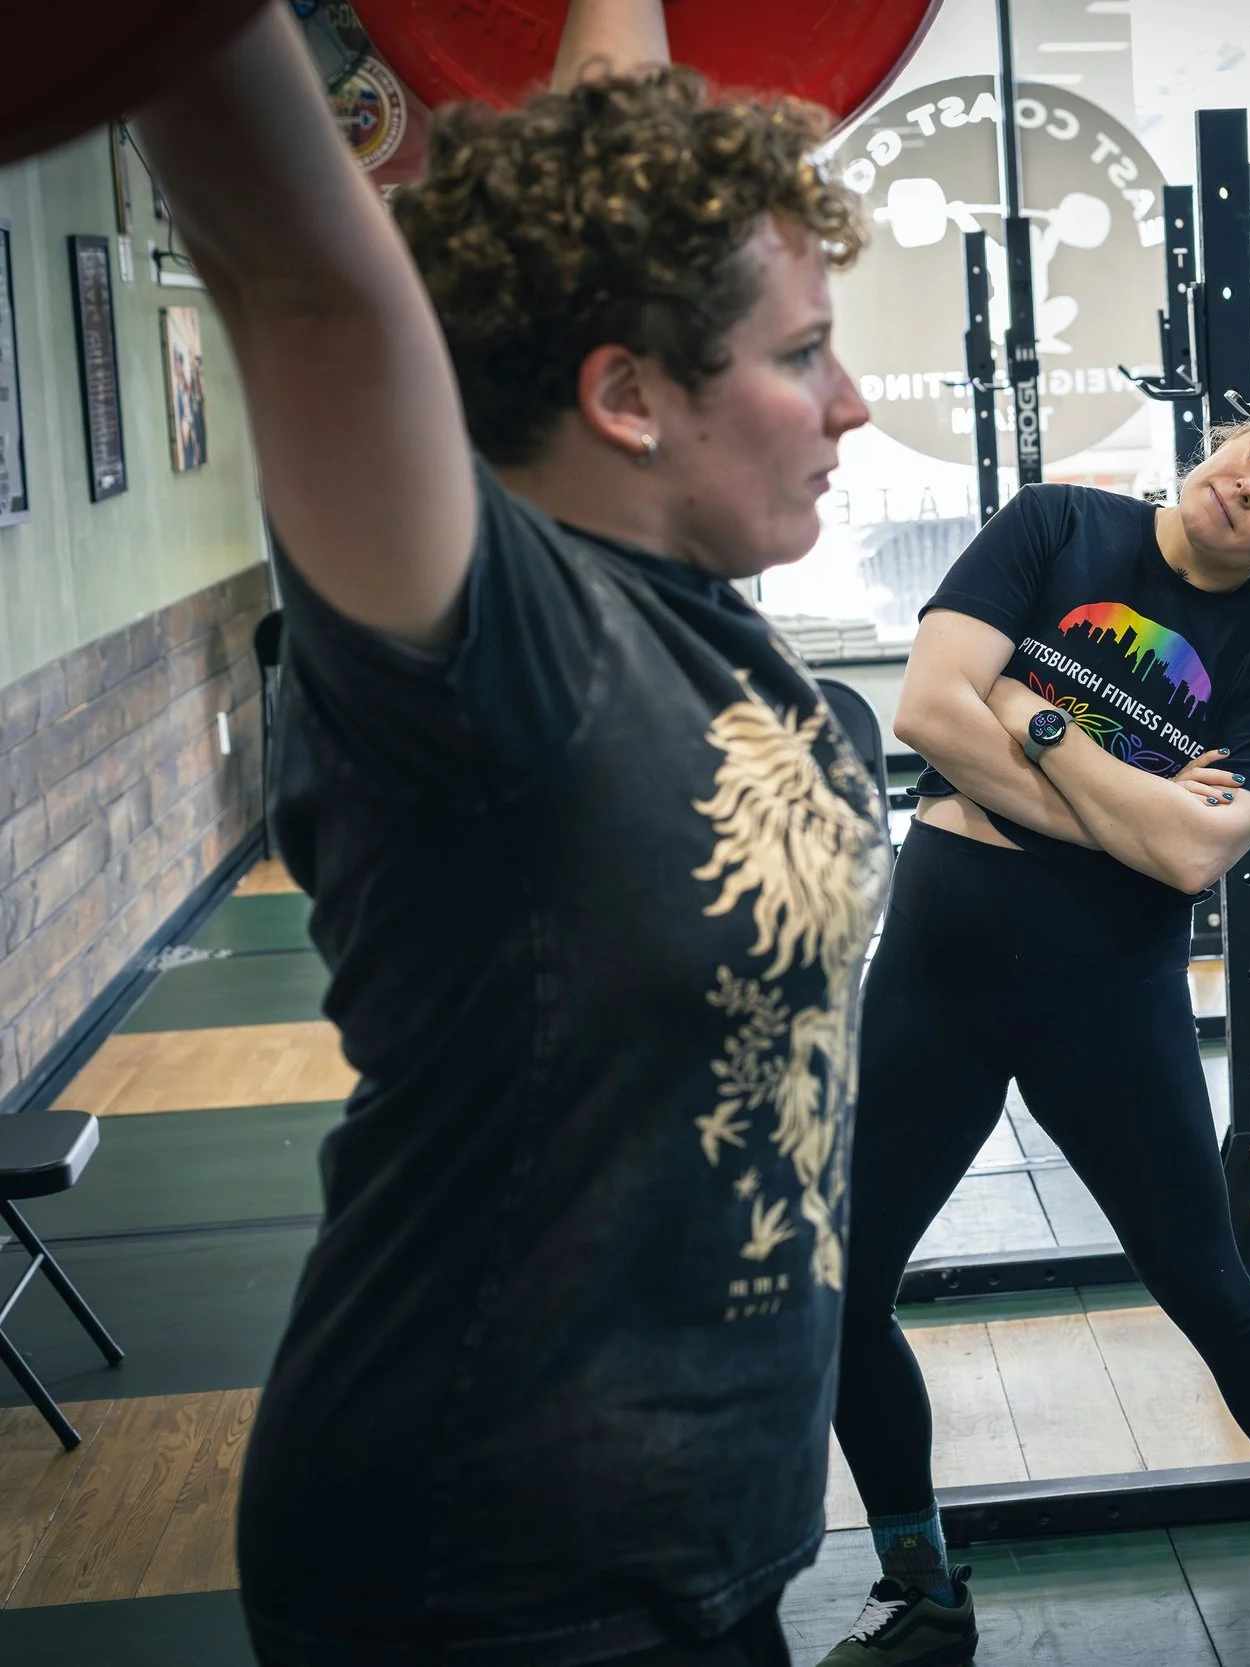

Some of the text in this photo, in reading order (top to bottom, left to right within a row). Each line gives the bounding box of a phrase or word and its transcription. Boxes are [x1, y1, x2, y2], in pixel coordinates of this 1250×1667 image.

[1018, 636, 1104, 693] PITTSBURGH
[1101, 682, 1163, 732] FITNESS
[1159, 721, 1205, 761] PROJE
